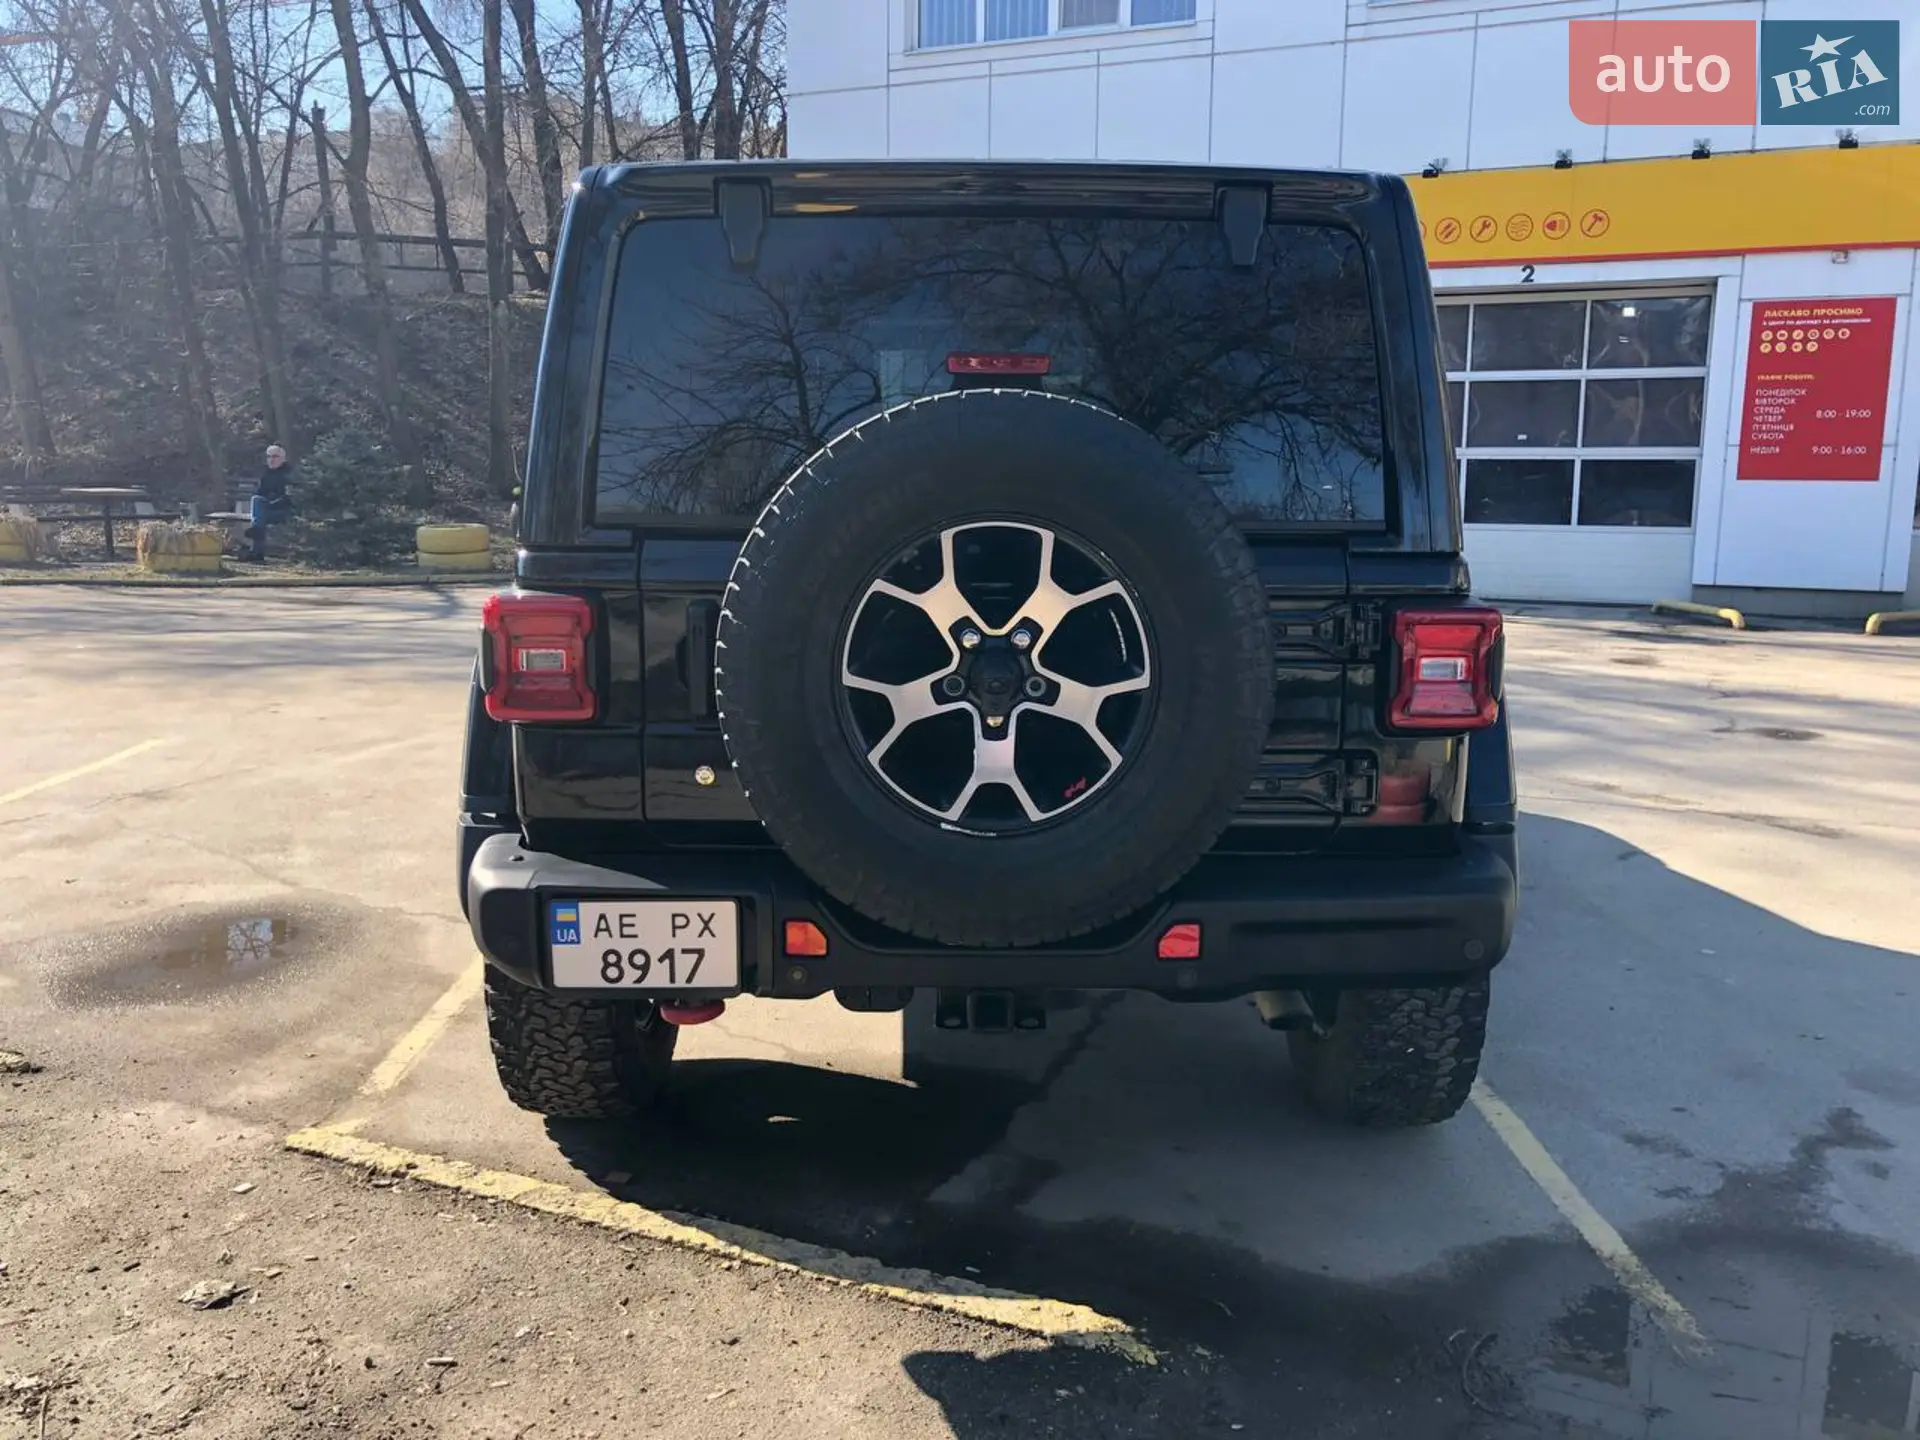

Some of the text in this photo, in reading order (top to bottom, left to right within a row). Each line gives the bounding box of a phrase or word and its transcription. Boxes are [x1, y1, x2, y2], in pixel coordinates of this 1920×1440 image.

[1520, 264, 1536, 283] 2
[1763, 307, 1864, 318] ЛАСКАВО ПРОСИМО
[1755, 388, 1807, 397] ПОНЕДІЛОК
[1753, 406, 1786, 414] СЕРЕДА
[1815, 410, 1837, 418] 8:00
[1845, 409, 1872, 418] 19:00
[1751, 432, 1785, 440] СУБОТА
[1750, 446, 1780, 454] НЕДІЛЯ
[1811, 446, 1832, 454] 9:00
[1841, 446, 1867, 455] 16:00
[556, 912, 717, 942] UA AE PX
[600, 948, 706, 985] 8917
